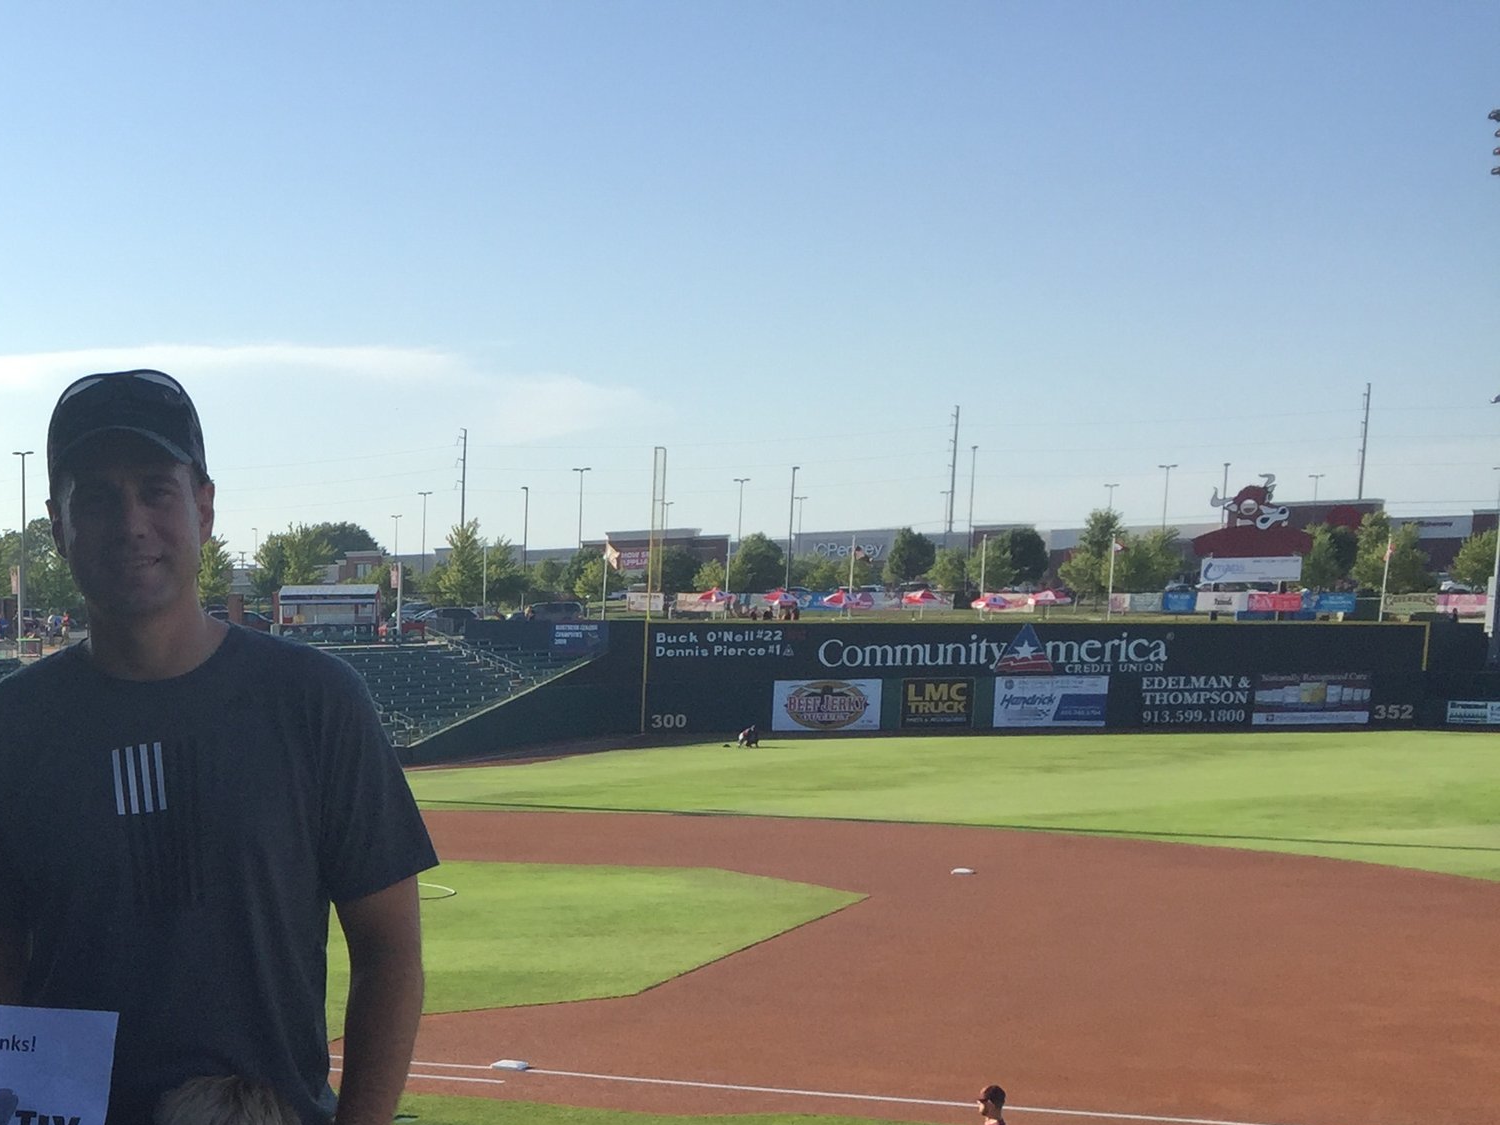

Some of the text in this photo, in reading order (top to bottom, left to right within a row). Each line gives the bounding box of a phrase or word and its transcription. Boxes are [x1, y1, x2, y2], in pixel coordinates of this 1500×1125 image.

[656, 632, 698, 643] Buck
[655, 646, 709, 658] Dennis
[713, 645, 766, 657] Pierce
[1065, 663, 1163, 674] CREDIT UNION
[1142, 677, 1252, 690] EDELMAN &
[908, 683, 967, 700] LMC
[1142, 691, 1248, 705] THOMPSON
[907, 701, 967, 714] TRUCK
[1373, 704, 1414, 719] 352
[651, 714, 687, 729] 300
[1142, 708, 1246, 723] 913.599.1800
